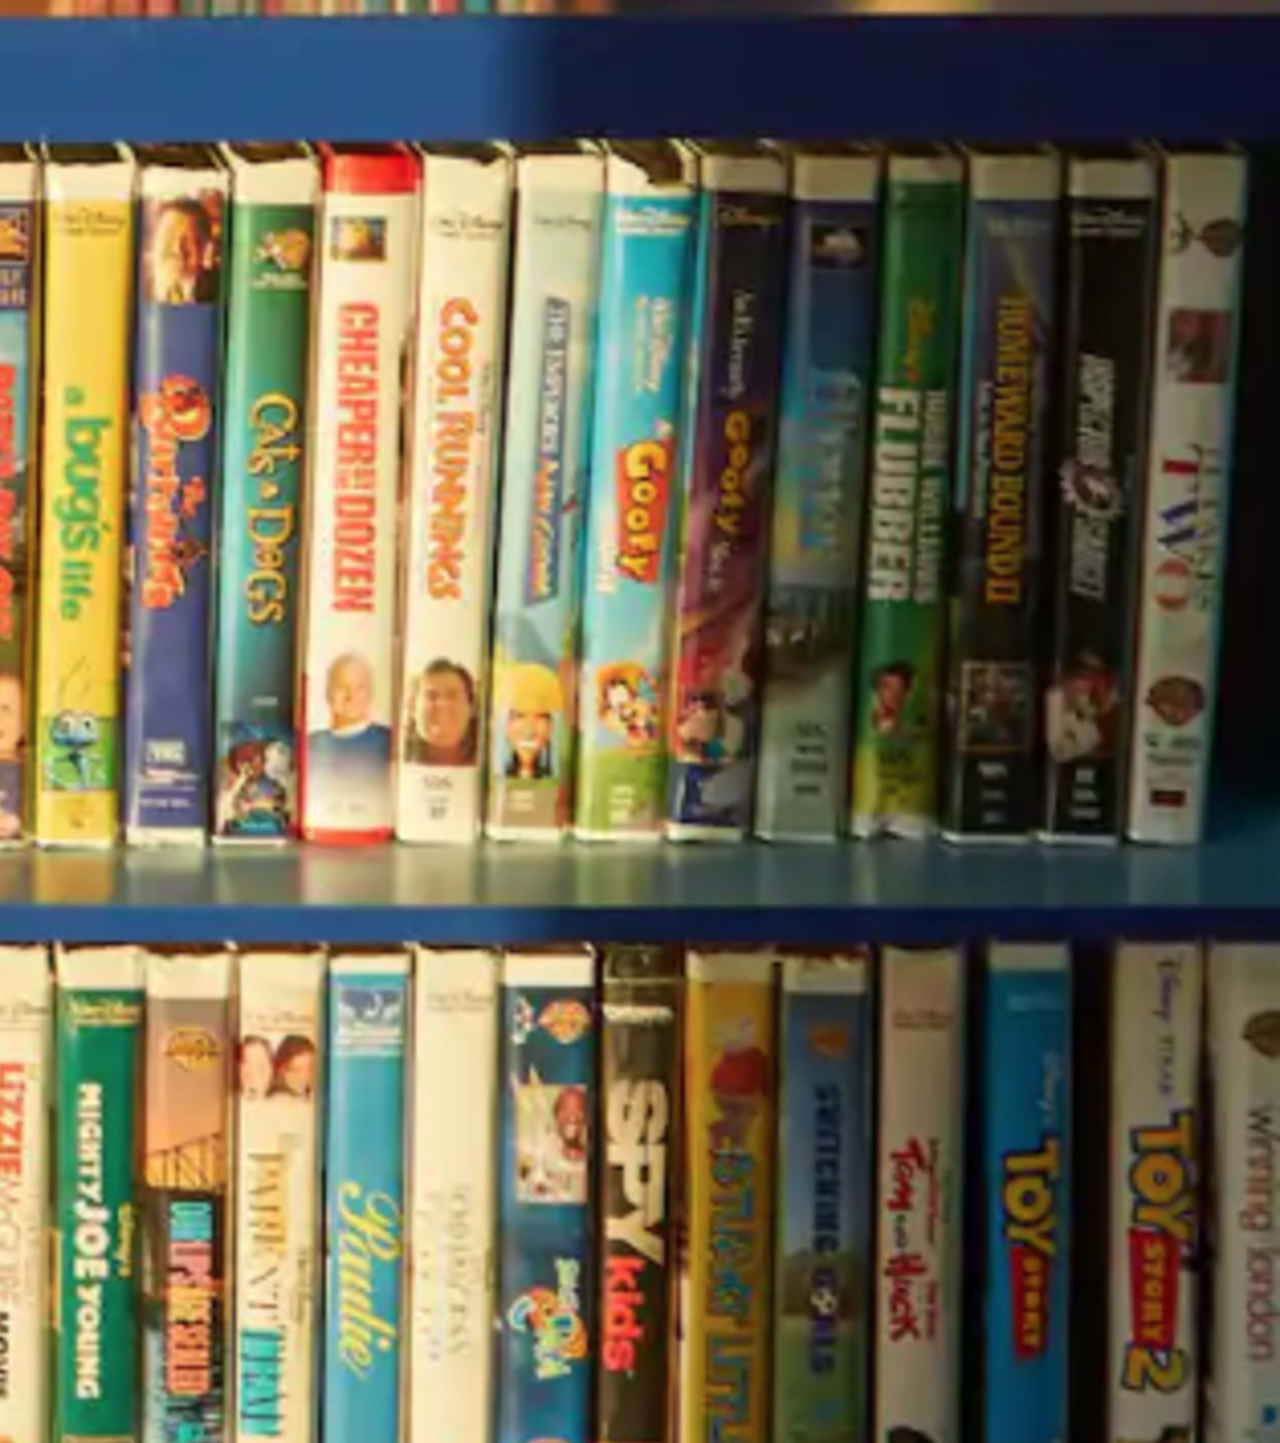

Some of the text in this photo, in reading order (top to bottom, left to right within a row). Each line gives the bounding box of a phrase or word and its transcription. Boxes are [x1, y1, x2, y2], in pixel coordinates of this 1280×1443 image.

[332, 302, 381, 613] CHEAPER DOZEN
[426, 296, 479, 602] COOL RUNNINGS
[712, 409, 752, 534] Goofy
[990, 294, 1036, 470] HOMEWARD
[53, 385, 114, 622] a bug's life
[616, 438, 672, 578] Goofy
[868, 385, 916, 604] FLUBBER
[987, 472, 1028, 576] BOUND
[1156, 445, 1203, 612] TWO
[71, 1082, 111, 1400] MIGHTY JOE YOUNG
[246, 1151, 288, 1320] PARENT
[602, 1077, 673, 1375] SPY kids
[814, 1083, 844, 1254] SWITCHING
[884, 1136, 928, 1344] TOM HUCK
[1001, 1135, 1064, 1257] TOY
[1121, 1109, 1202, 1393] TOY STORY 2
[336, 1180, 405, 1382] Paulie
